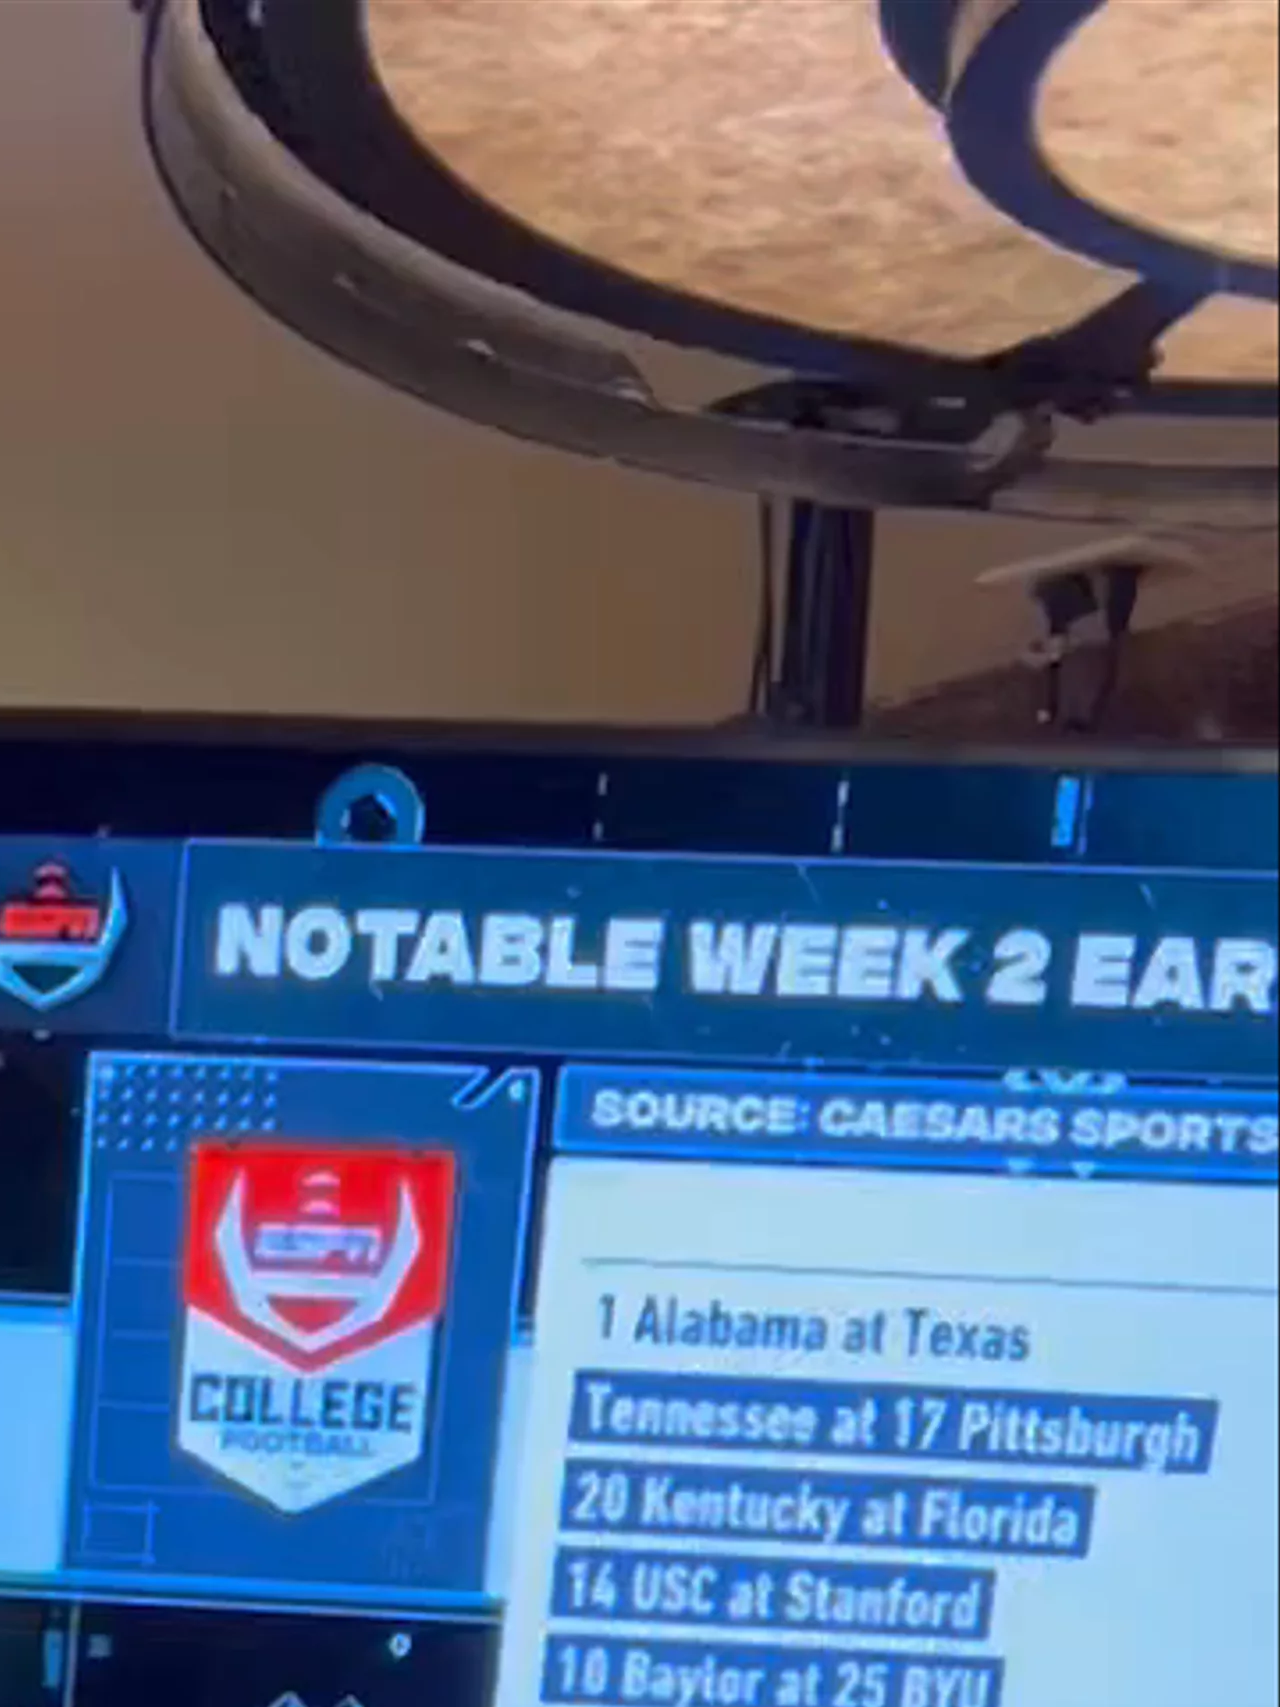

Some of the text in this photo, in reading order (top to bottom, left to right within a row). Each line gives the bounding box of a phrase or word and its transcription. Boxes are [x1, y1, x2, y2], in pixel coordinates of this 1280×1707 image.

[215, 902, 1278, 1011] NOTABLE WEEK 2 EAR
[592, 1090, 1278, 1155] SOURCE: CAESARS SPORTS
[600, 1294, 1032, 1362] 1 Alabama at Texas
[190, 1374, 416, 1433] COLLEGE
[585, 1383, 1200, 1473] Tennessee at 17 Pittsburgh
[572, 1472, 1080, 1547] 20 Kentucky at Florida
[567, 1561, 982, 1630] 14 USC at Stanford
